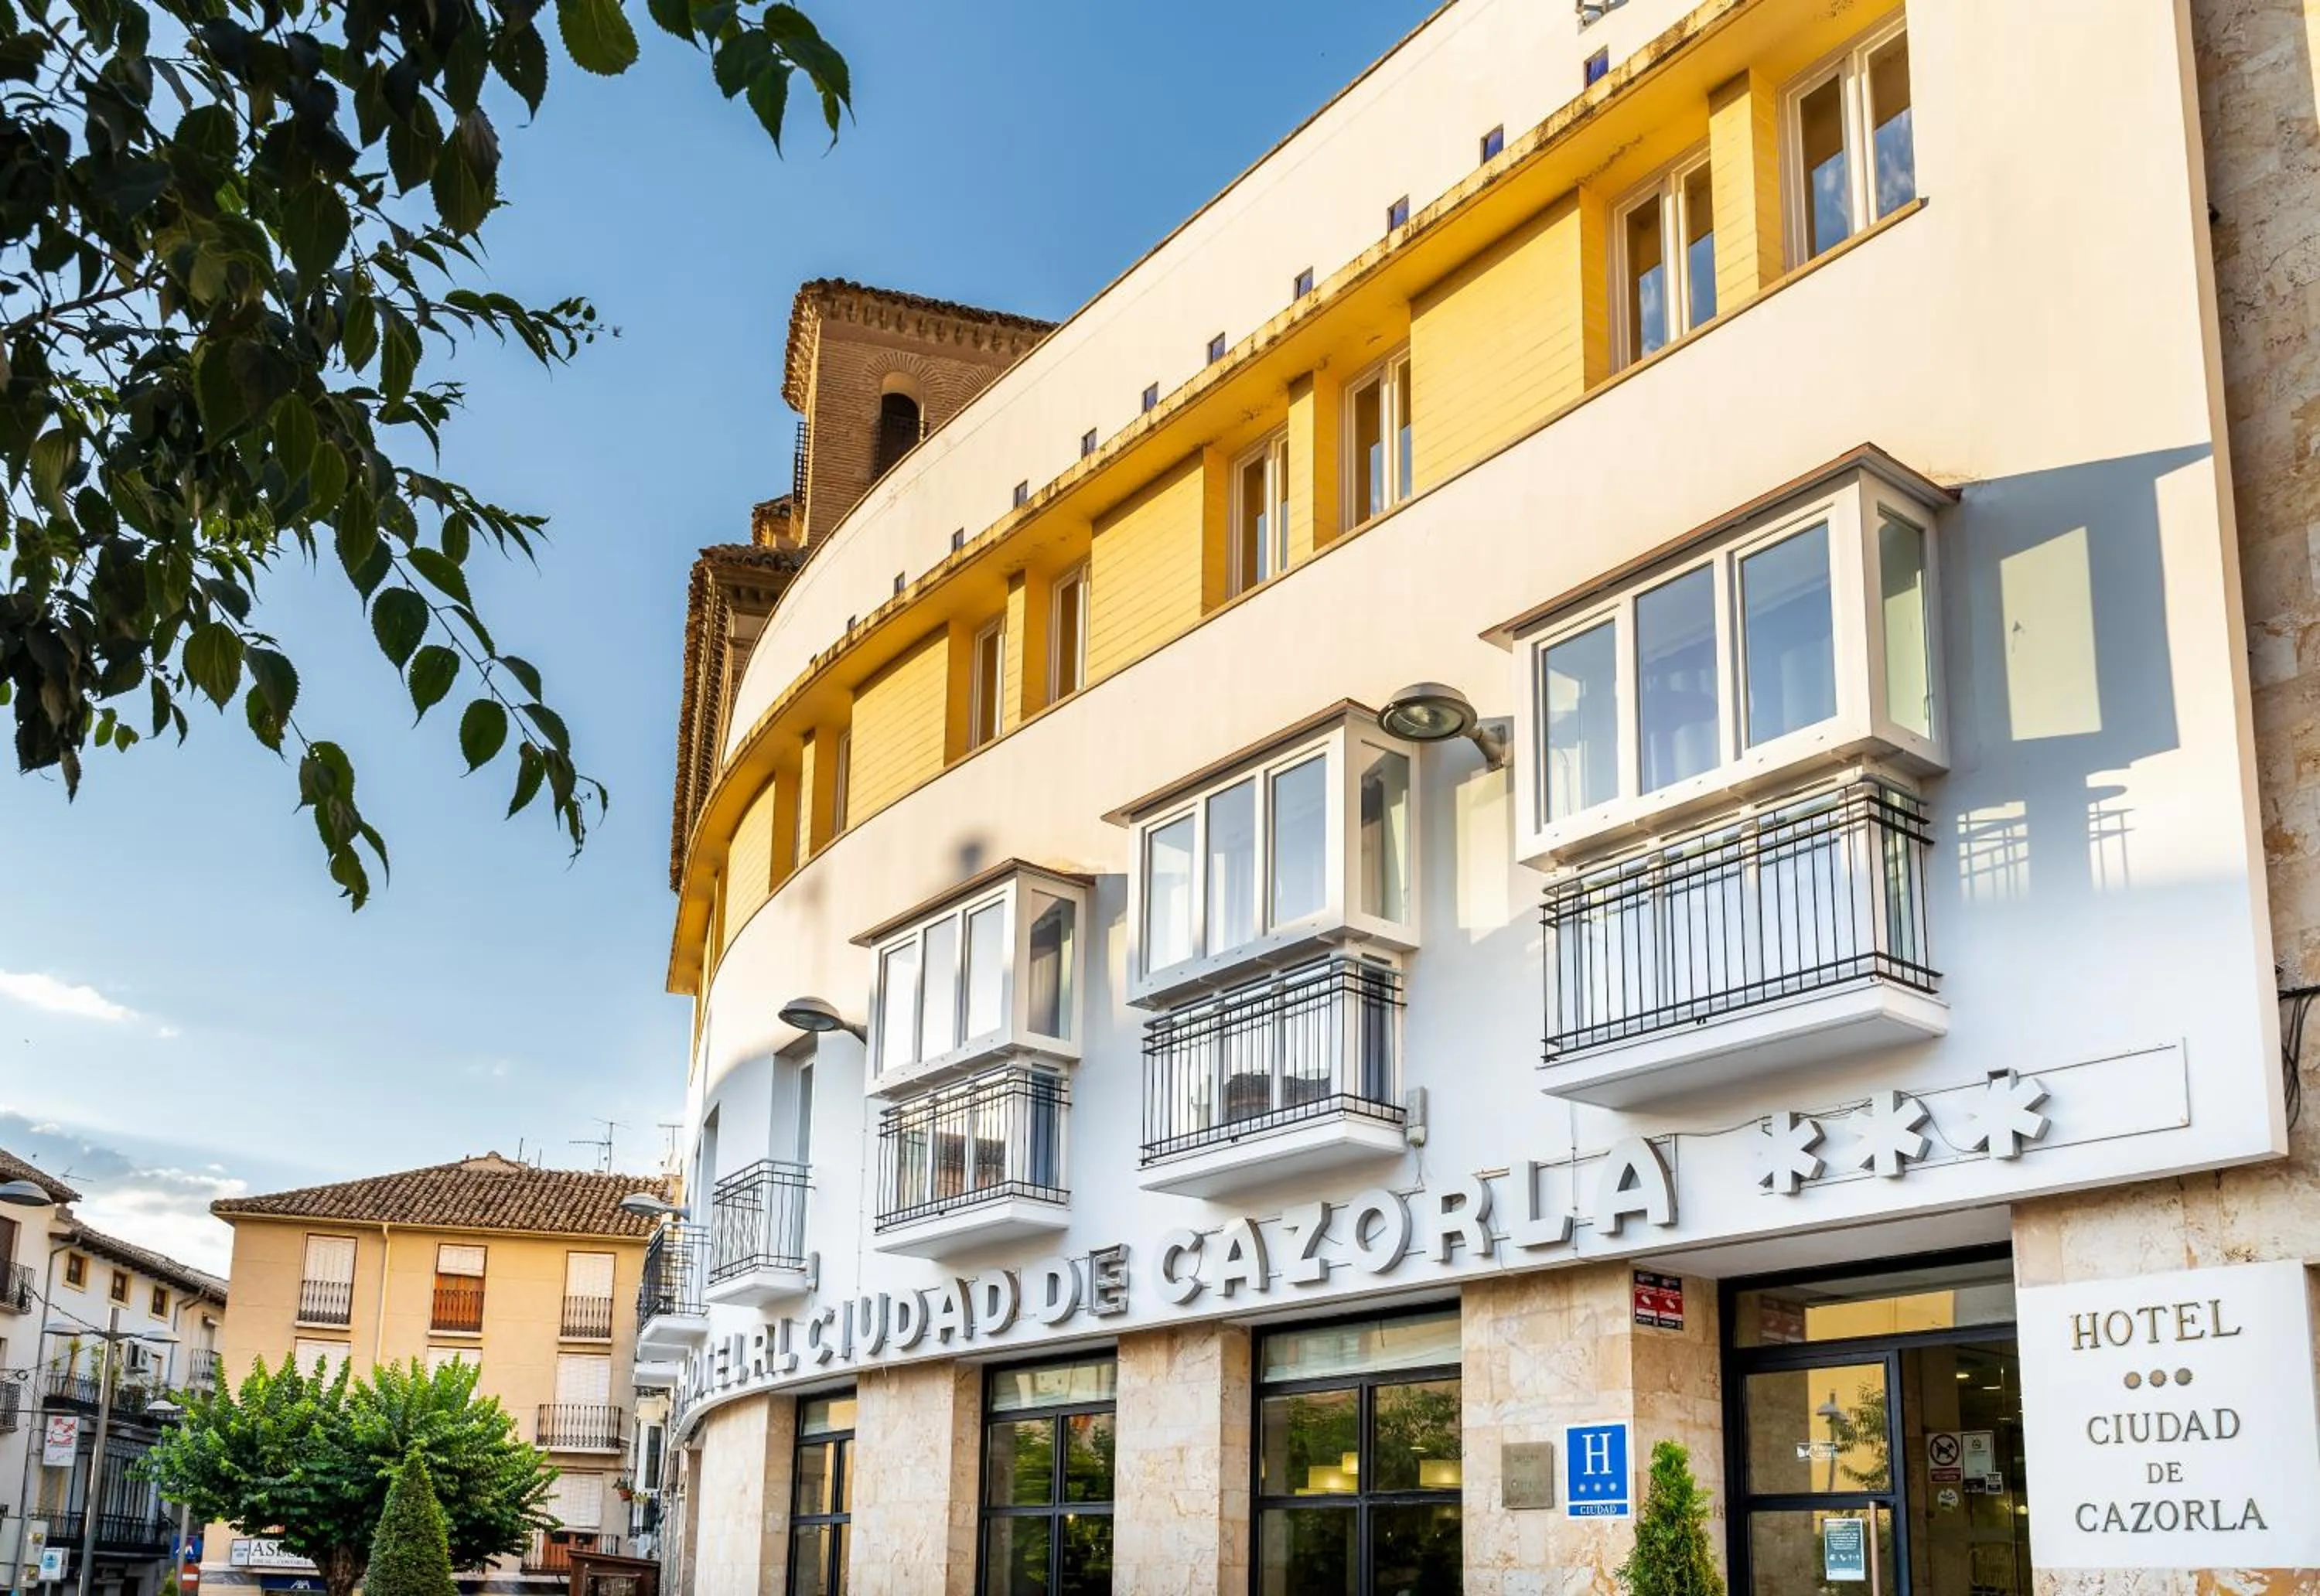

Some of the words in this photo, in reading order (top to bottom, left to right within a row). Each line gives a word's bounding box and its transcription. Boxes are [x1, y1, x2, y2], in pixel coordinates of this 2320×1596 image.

[807, 1269, 1021, 1364] CIUDAD
[1036, 1243, 1130, 1325] DE
[1152, 1137, 1679, 1304] CAZORLA
[2070, 1299, 2242, 1350] HOTEL
[2086, 1408, 2241, 1445] CIUDAD
[1581, 1433, 1612, 1475] H
[2147, 1461, 2183, 1484] DE
[1580, 1505, 1617, 1516] CIUDAD
[2075, 1498, 2269, 1533] CAZORLA
